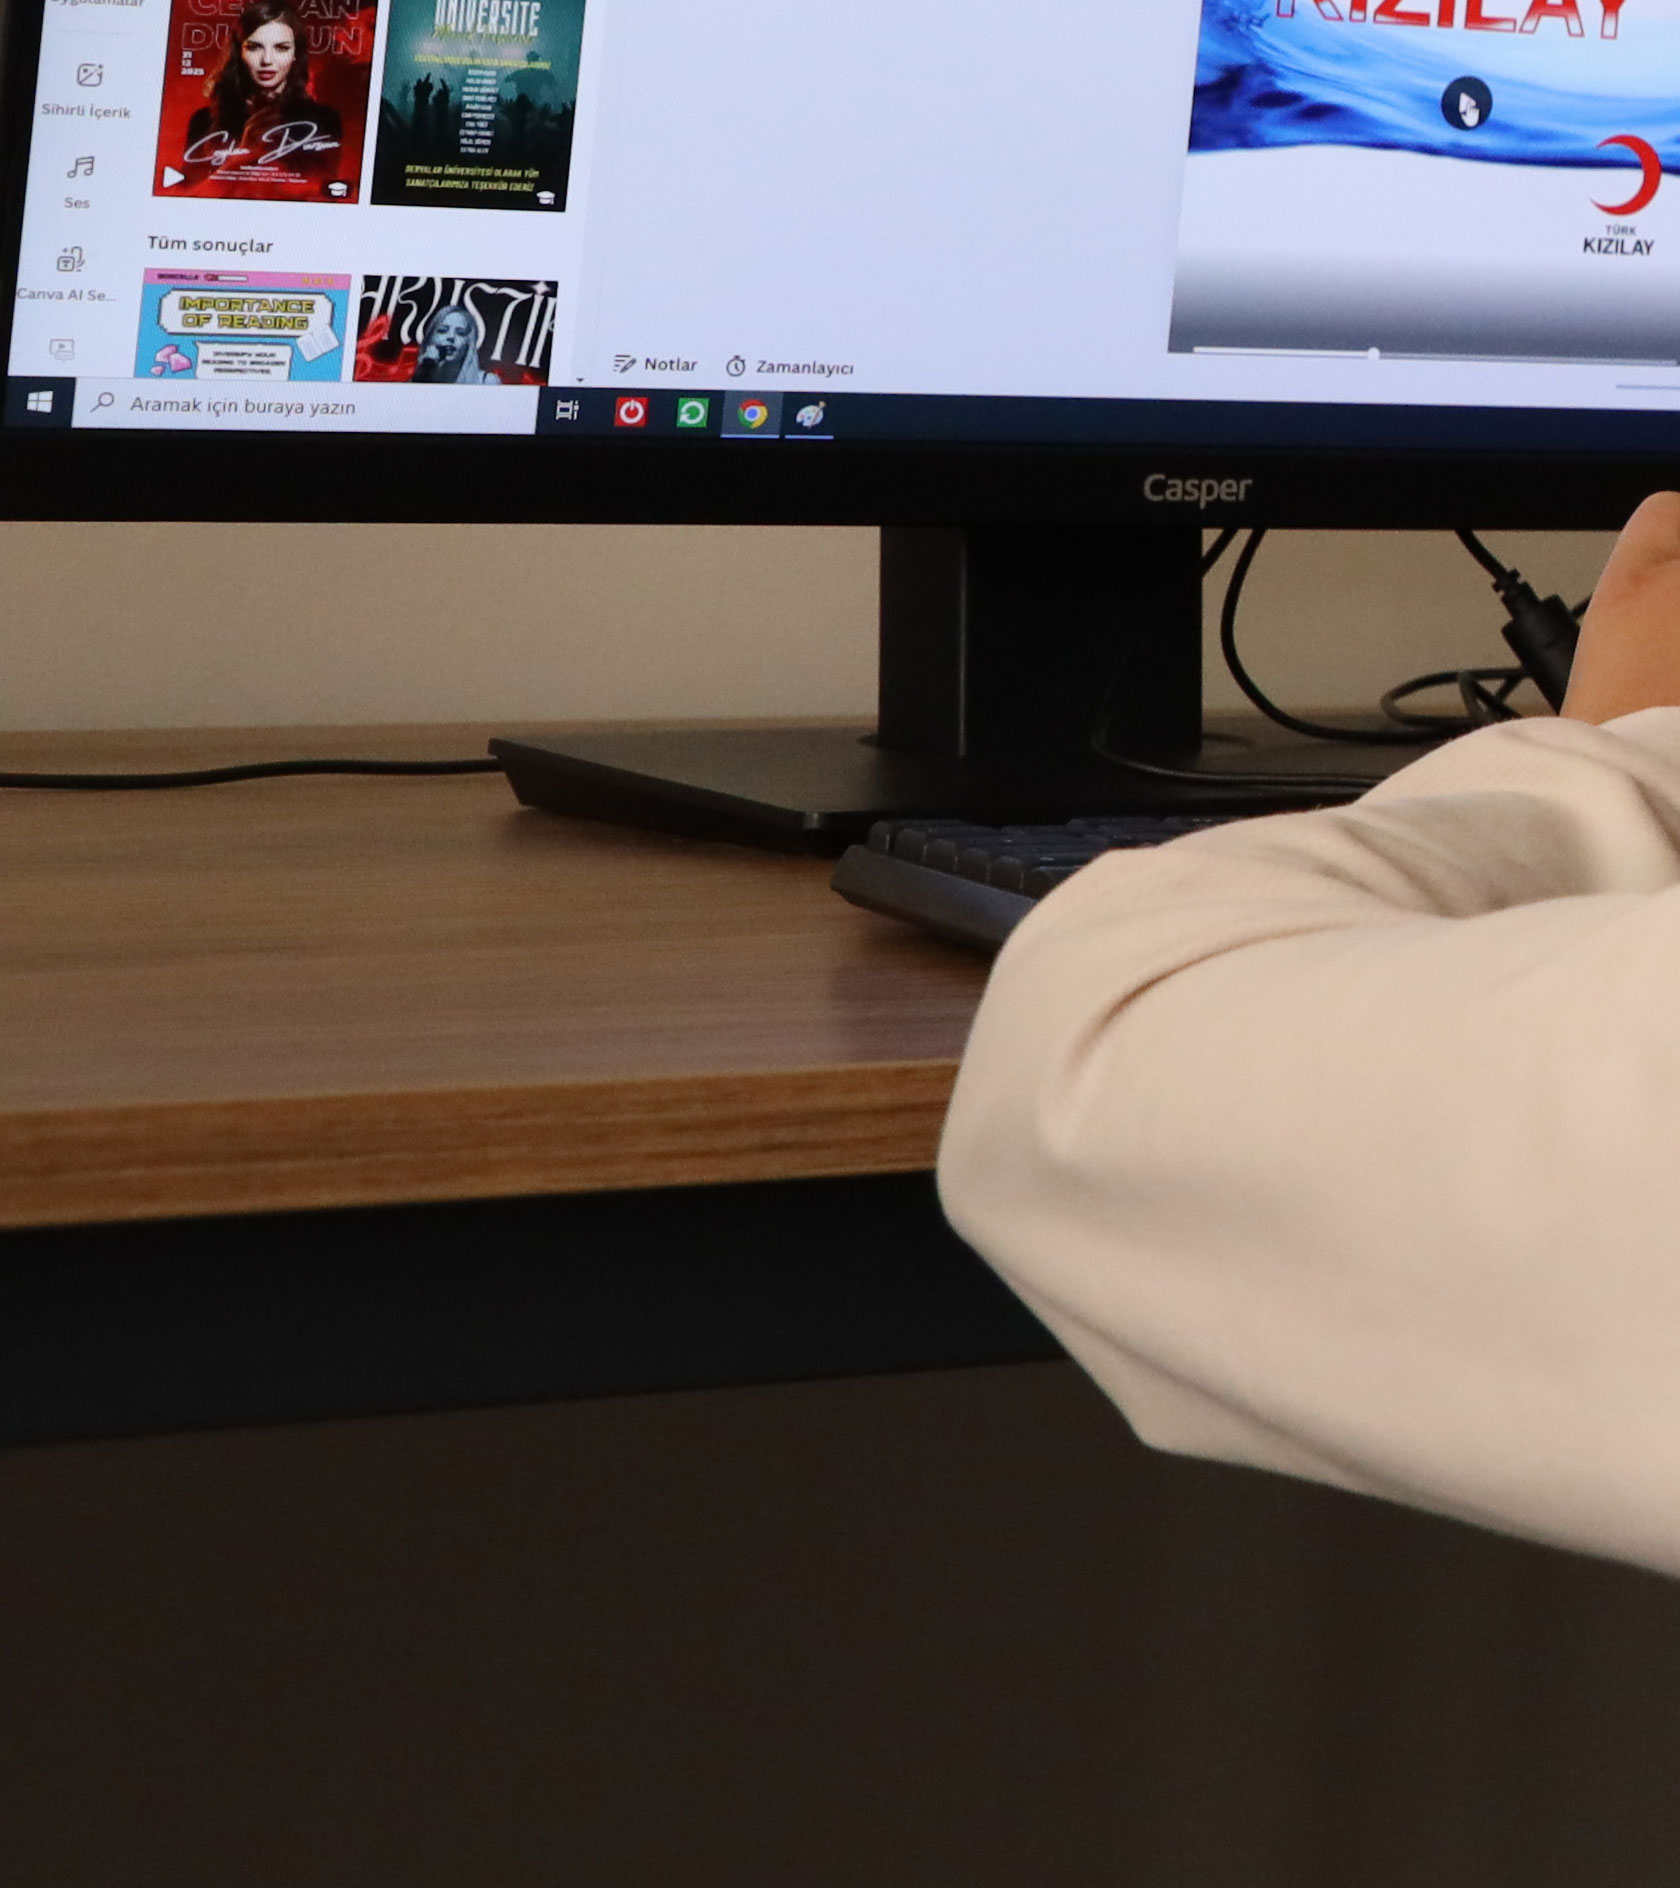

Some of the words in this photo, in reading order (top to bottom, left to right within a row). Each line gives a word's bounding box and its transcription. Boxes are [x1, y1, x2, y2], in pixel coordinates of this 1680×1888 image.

[89, 103, 131, 119] İçerik
[64, 197, 90, 209] Ses
[1605, 223, 1637, 236] TÜRK
[148, 235, 187, 250] Tüm
[193, 238, 274, 255] sonuçlar
[1583, 237, 1655, 256] KIZILAY
[16, 287, 64, 301] Canva
[67, 288, 83, 301] AI
[179, 295, 315, 313] IMPORTANCE
[182, 313, 212, 327] OF
[218, 314, 309, 330] READING
[645, 356, 698, 372] Notlar
[756, 360, 854, 378] Zamanlayıcı
[130, 395, 201, 413] Aramak
[206, 397, 238, 417] için
[245, 398, 305, 417] buraya
[309, 401, 356, 417] yazın
[1142, 473, 1253, 510] Casper
